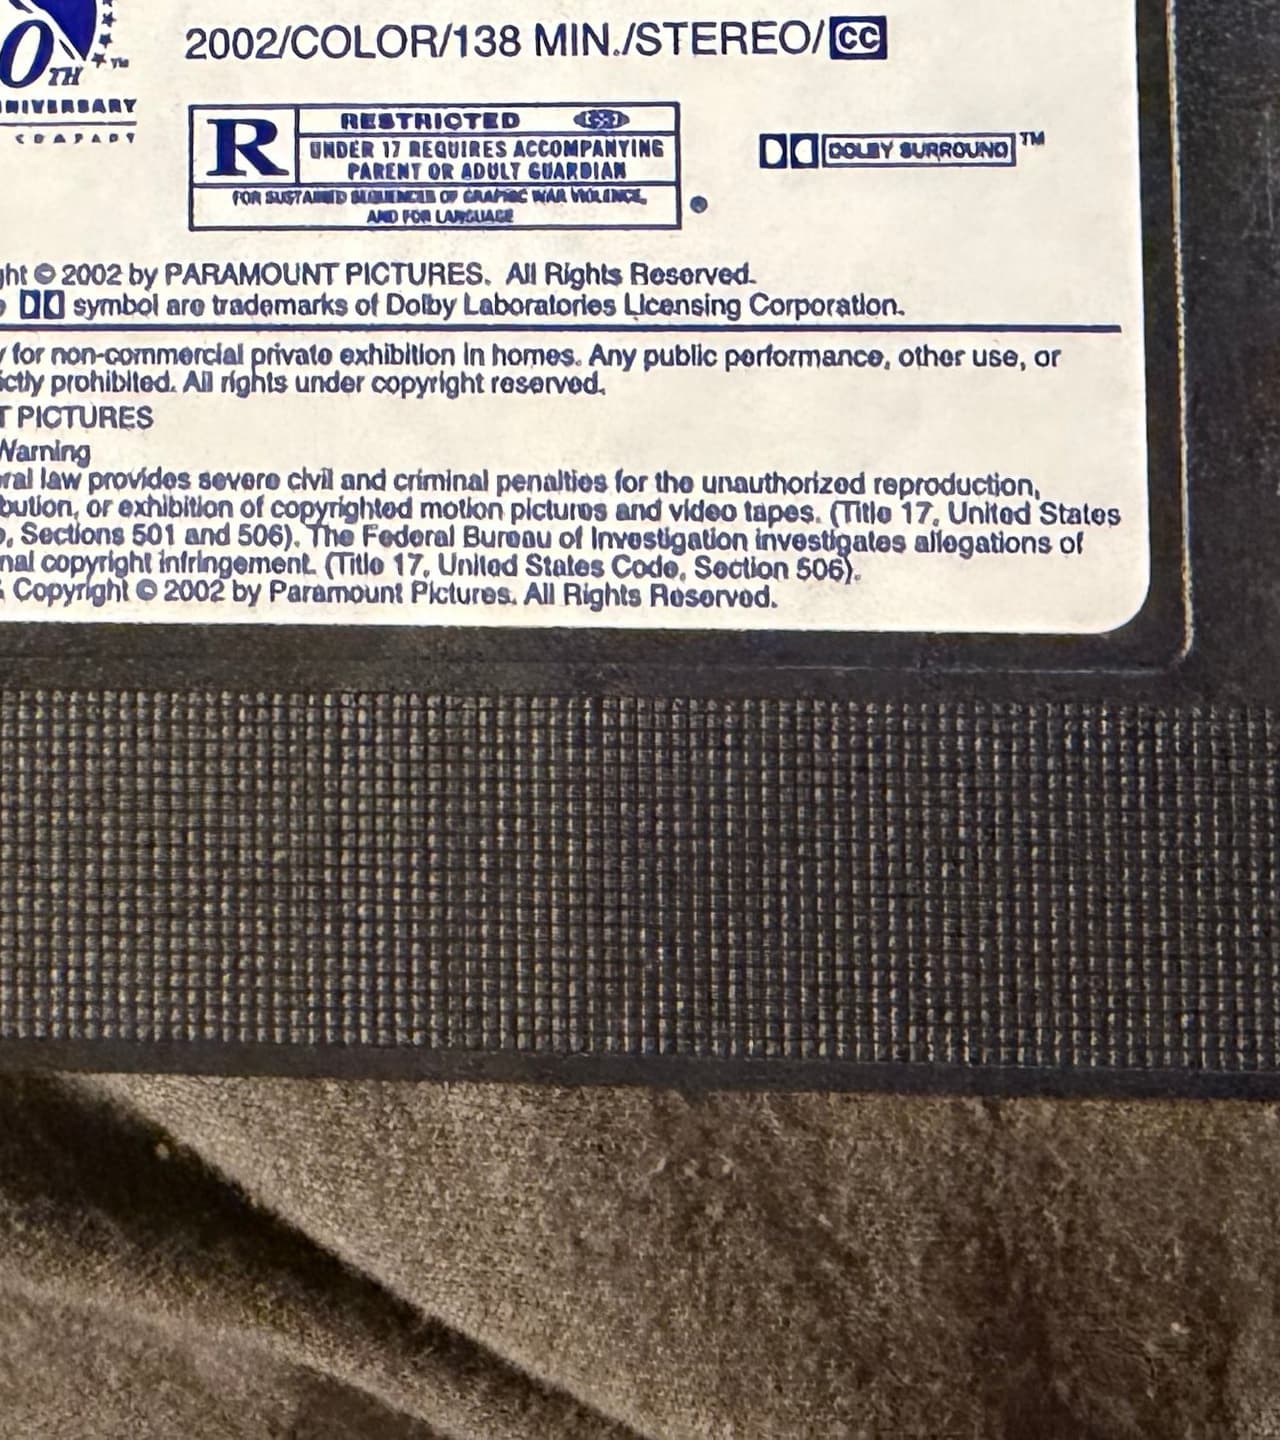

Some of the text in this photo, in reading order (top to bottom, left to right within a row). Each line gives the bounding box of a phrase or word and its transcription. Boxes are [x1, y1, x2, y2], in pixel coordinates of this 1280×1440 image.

[185, 24, 522, 60] 2002/COLOR/138
[340, 111, 521, 130] RESTRICTED
[205, 117, 290, 177] R
[309, 139, 665, 159] UNDER 17 REQUIRES ACCOMPANYING
[347, 161, 628, 181] PARENT OR ADULT GUARDIAN
[61, 261, 123, 287] 2002
[128, 261, 159, 293] by
[164, 261, 340, 287] PARAMOUNT
[345, 262, 492, 287] PICTURES.
[505, 262, 537, 287] All
[544, 262, 623, 293] Rights
[630, 262, 757, 287] Reserved.
[73, 292, 159, 324] symbol
[166, 297, 206, 318] are
[212, 292, 349, 318] trademarks
[354, 292, 379, 318] of
[386, 293, 458, 324] Dolby
[463, 293, 617, 318] Laboratories
[624, 293, 742, 324] Licensing
[749, 293, 905, 324] Corporation.
[12, 342, 46, 367] for
[50, 342, 244, 367] non-commercial
[251, 342, 333, 373] private
[339, 343, 456, 368] exhibition
[463, 343, 485, 368] in
[492, 343, 582, 368] homes.
[588, 344, 637, 375] Any
[643, 344, 718, 375] public
[724, 344, 891, 375] performance,
[898, 345, 966, 370] other
[972, 350, 1026, 373] use,
[1034, 350, 1062, 370] or
[17, 404, 154, 429] PICTURES
[40, 468, 82, 493] law
[88, 468, 192, 499] provides
[198, 473, 281, 493] severe
[287, 469, 334, 494] civil
[340, 469, 387, 494] and
[393, 469, 489, 494] criminal
[496, 470, 609, 501] penalties
[614, 470, 649, 495] for
[654, 470, 694, 495] the
[702, 471, 866, 496] unauthorized
[873, 472, 1041, 503] reproduction,
[86, 501, 113, 520] or
[118, 496, 234, 520] exhibition
[239, 497, 264, 521] of
[270, 497, 413, 527] copyrighted
[420, 498, 504, 522] motion
[510, 498, 608, 529] pictures
[615, 499, 663, 523] and
[668, 499, 738, 524] video
[743, 499, 821, 530] tapes.
[829, 500, 892, 527] (Title
[901, 500, 940, 528] 17,
[948, 500, 1031, 525] United
[1039, 501, 1122, 526] States
[20, 523, 125, 548] Sections
[132, 524, 175, 548] 501
[184, 524, 231, 549] and
[237, 525, 300, 552] 506).
[308, 525, 355, 550] The
[362, 526, 455, 550] Federal
[463, 526, 552, 551] Bureau
[558, 527, 583, 551] of
[591, 528, 748, 558] Investigation
[755, 529, 907, 559] investigates
[914, 530, 1053, 560] allegations
[1059, 531, 1084, 555] of
[40, 551, 152, 582] copyright
[324, 553, 385, 581] (Title
[393, 554, 430, 582] 17,
[438, 554, 518, 579] United
[525, 555, 605, 580] States
[611, 555, 686, 583] Code,
[694, 556, 789, 581] Section
[796, 557, 861, 585] 506).
